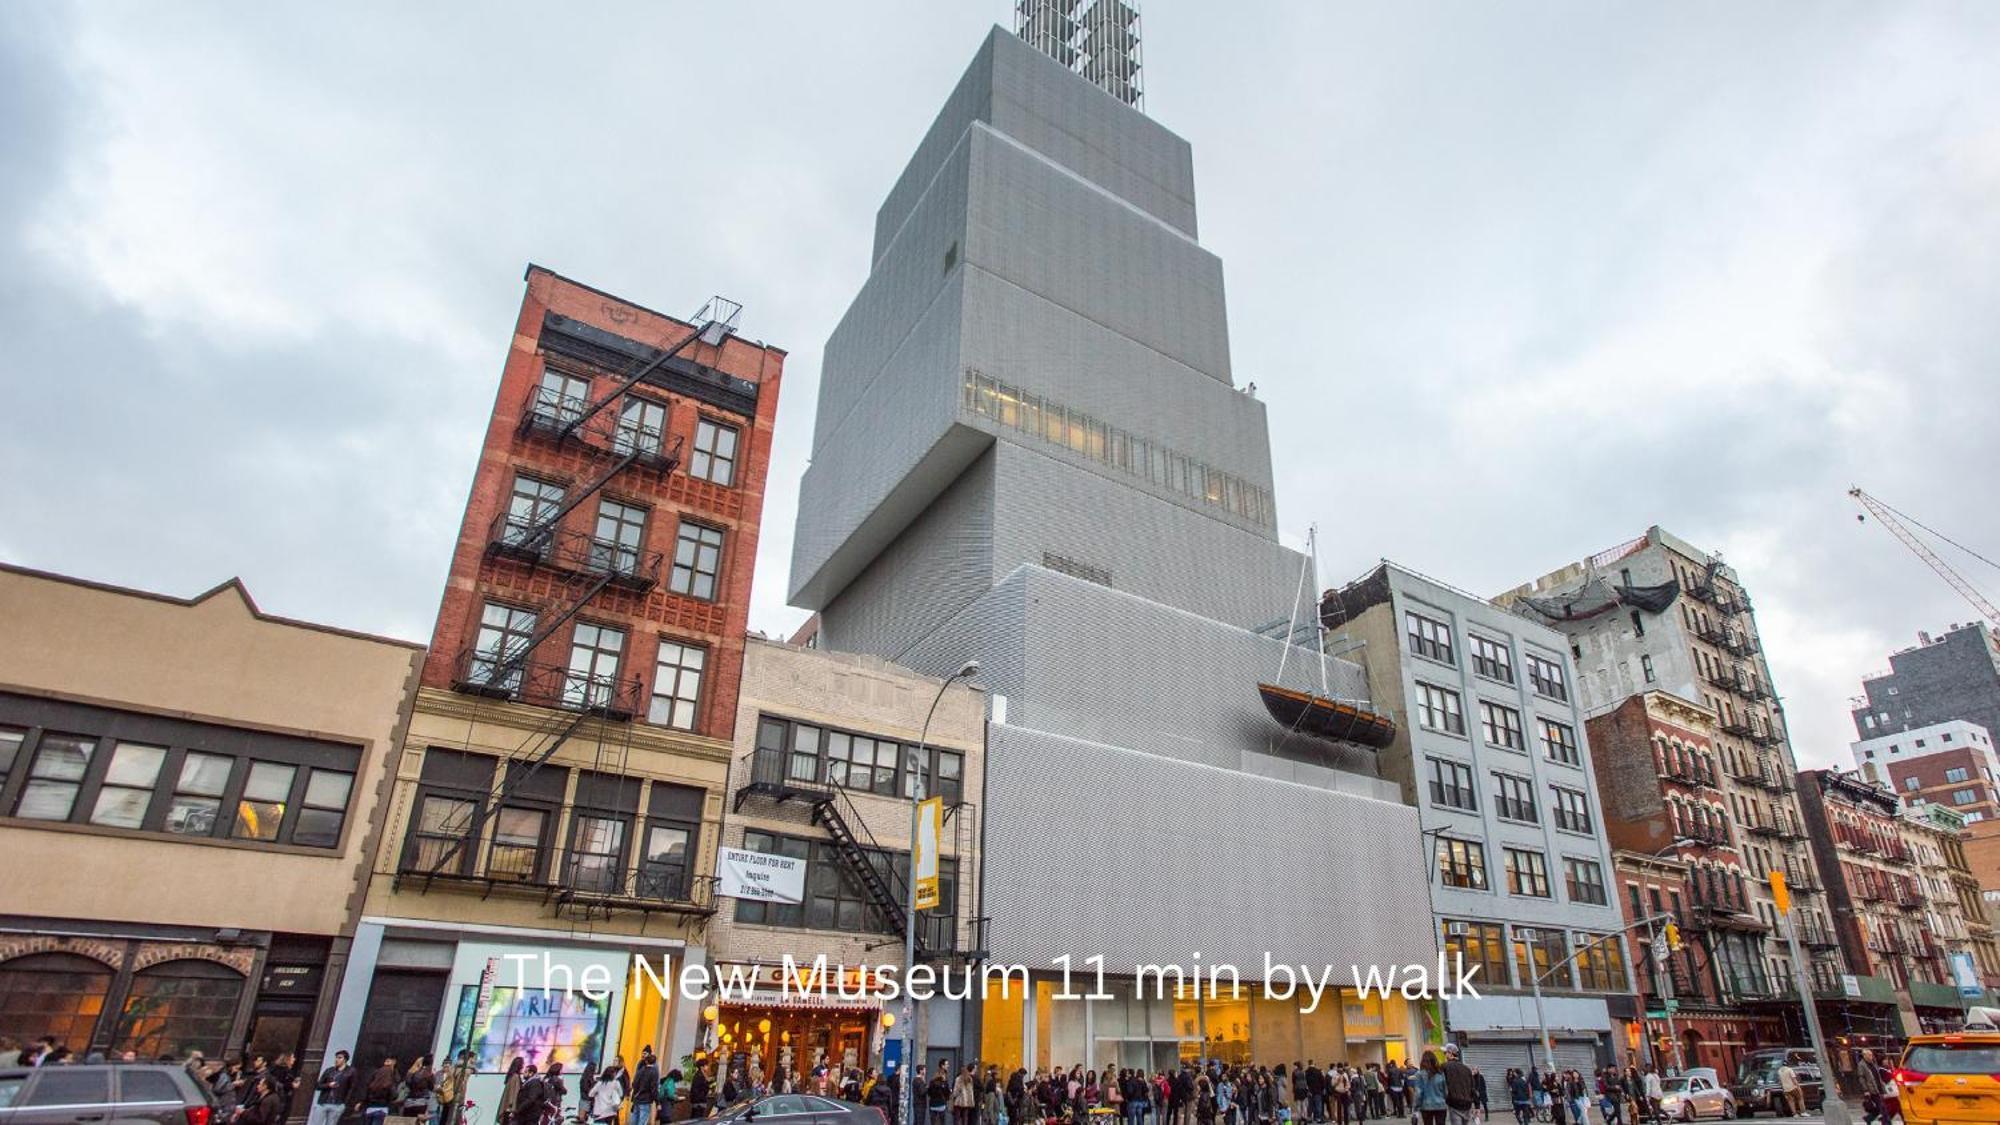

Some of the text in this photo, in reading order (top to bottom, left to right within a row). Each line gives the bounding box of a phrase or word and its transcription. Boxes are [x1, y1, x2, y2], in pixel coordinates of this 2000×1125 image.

[727, 851, 796, 871] ENTIRE FLOOR FOR RENT
